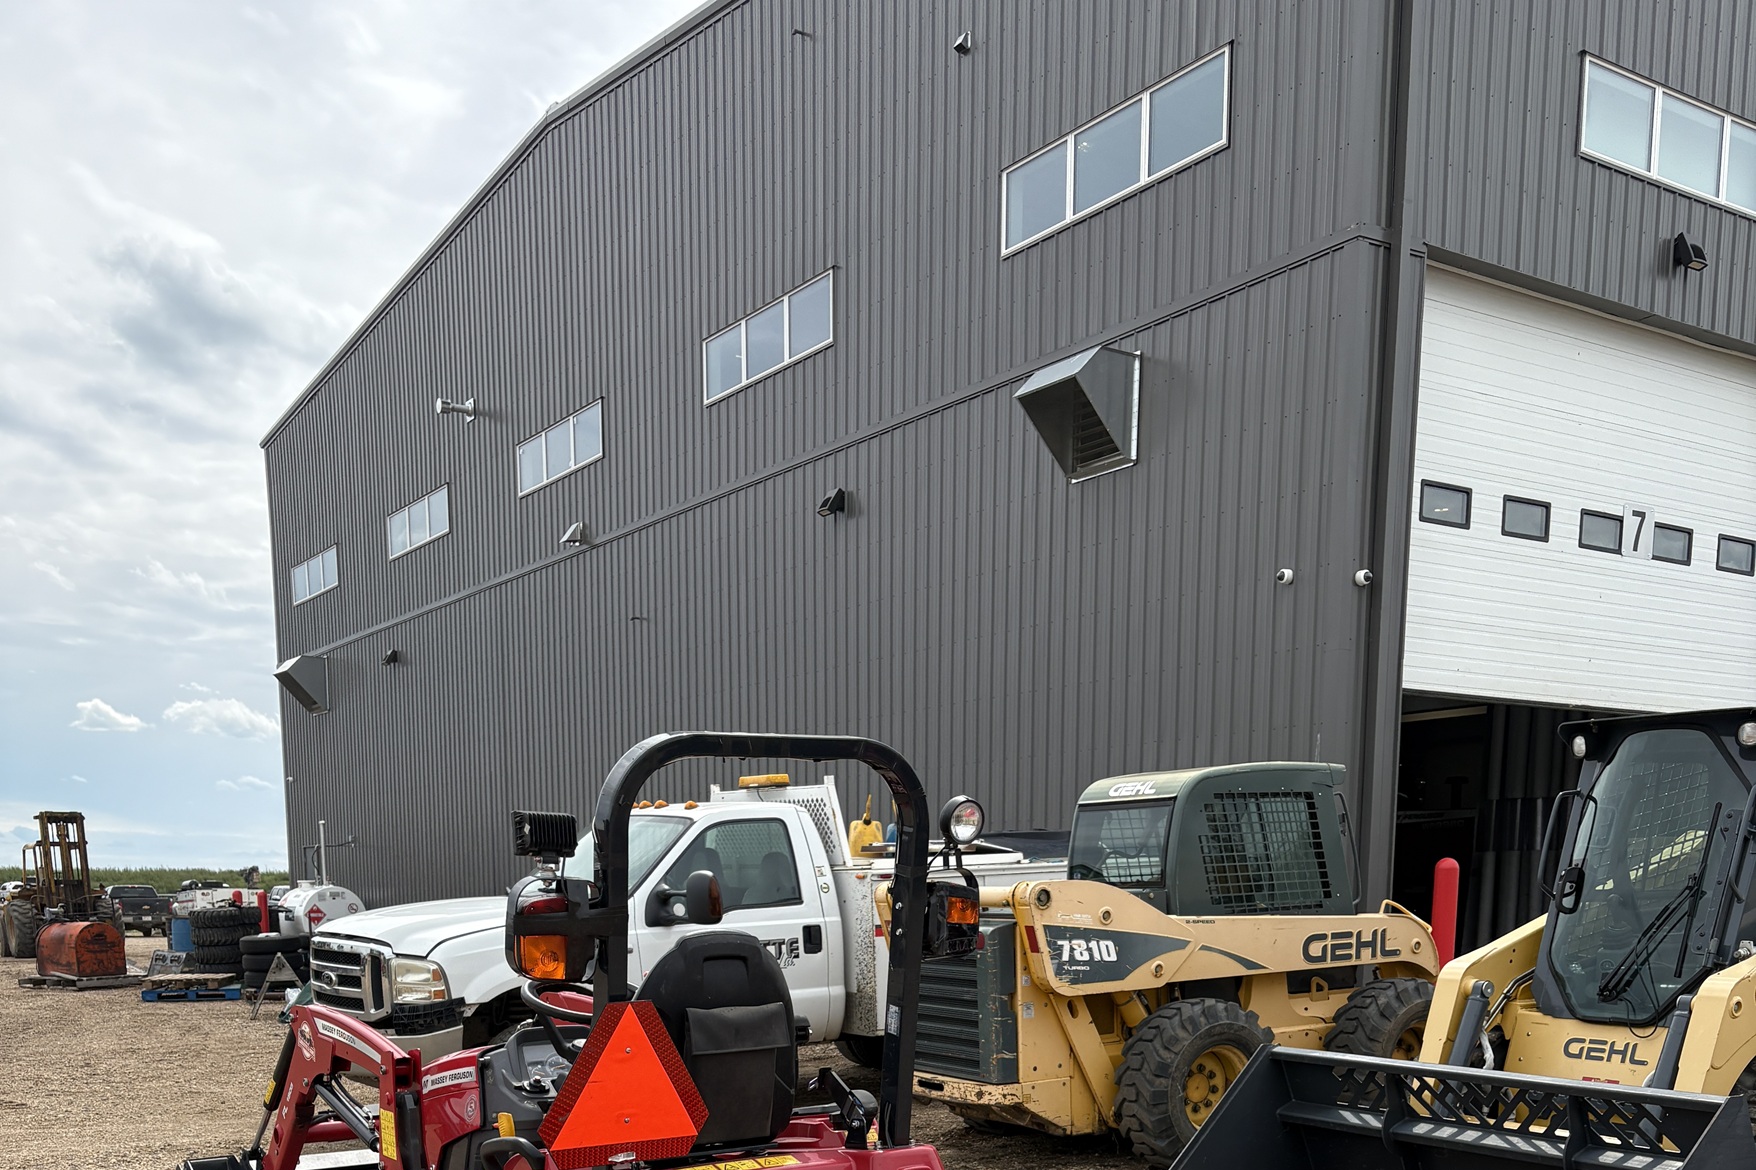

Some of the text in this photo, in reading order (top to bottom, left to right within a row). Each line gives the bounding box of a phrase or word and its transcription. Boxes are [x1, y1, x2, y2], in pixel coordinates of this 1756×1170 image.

[1632, 510, 1646, 552] 7
[1108, 780, 1157, 797] GEHL
[1057, 940, 1118, 962] 7810
[1302, 927, 1401, 963] GEHL
[336, 1028, 356, 1046] FERGUSON
[1563, 1037, 1649, 1066] GEHL
[430, 1070, 474, 1087] MASSEY FERGUSON
